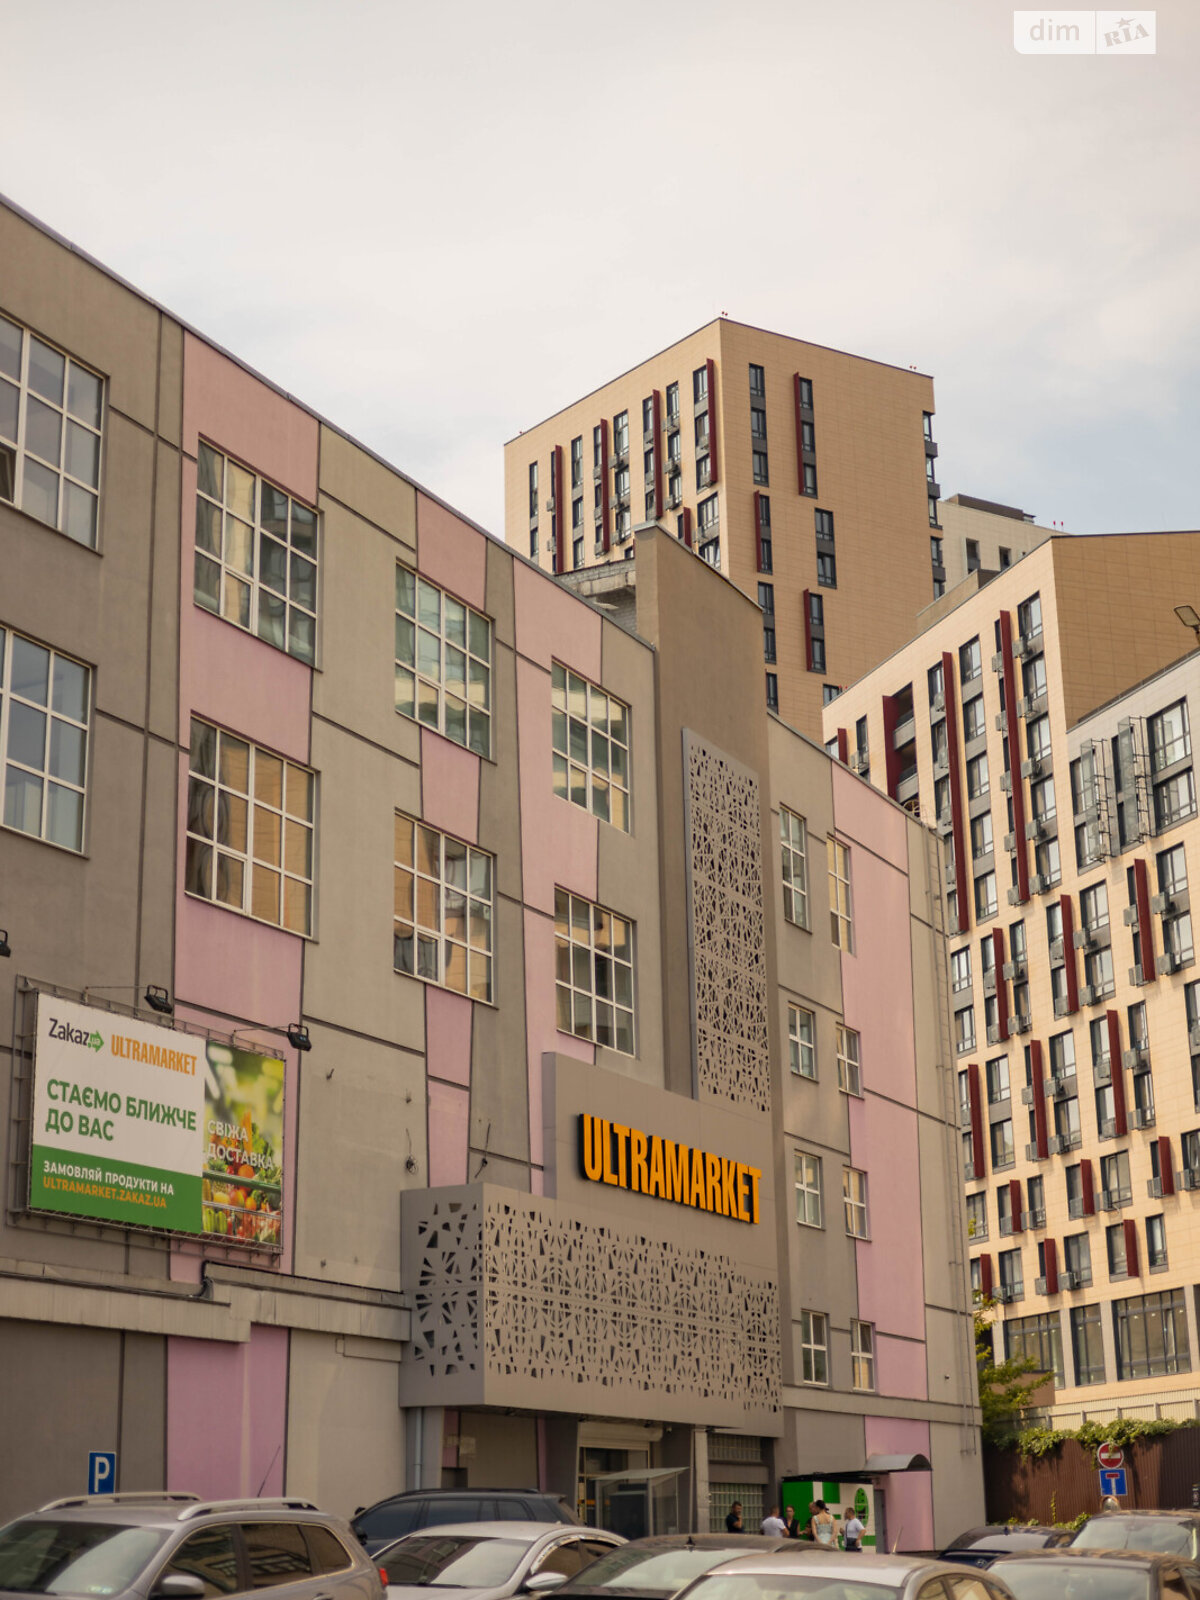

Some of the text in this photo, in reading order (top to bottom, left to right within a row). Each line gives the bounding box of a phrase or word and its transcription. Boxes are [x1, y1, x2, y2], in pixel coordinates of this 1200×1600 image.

[111, 1034, 197, 1076] ULTRAMARKET
[47, 1079, 197, 1131] СТАЄМО БЛИЖЧЕ
[45, 1108, 114, 1141] ДО ВАС
[207, 1120, 249, 1142] СВІЖА
[206, 1143, 274, 1171] ДОСТАВКА
[578, 1113, 762, 1225] ULTRAMARKET
[43, 1160, 174, 1196] ЗАМОВЛЯЙ ПРОДУКТИ НА
[43, 1176, 166, 1208] ULTRAMARKET.ZAKAZ.UA
[94, 1456, 110, 1493] P
